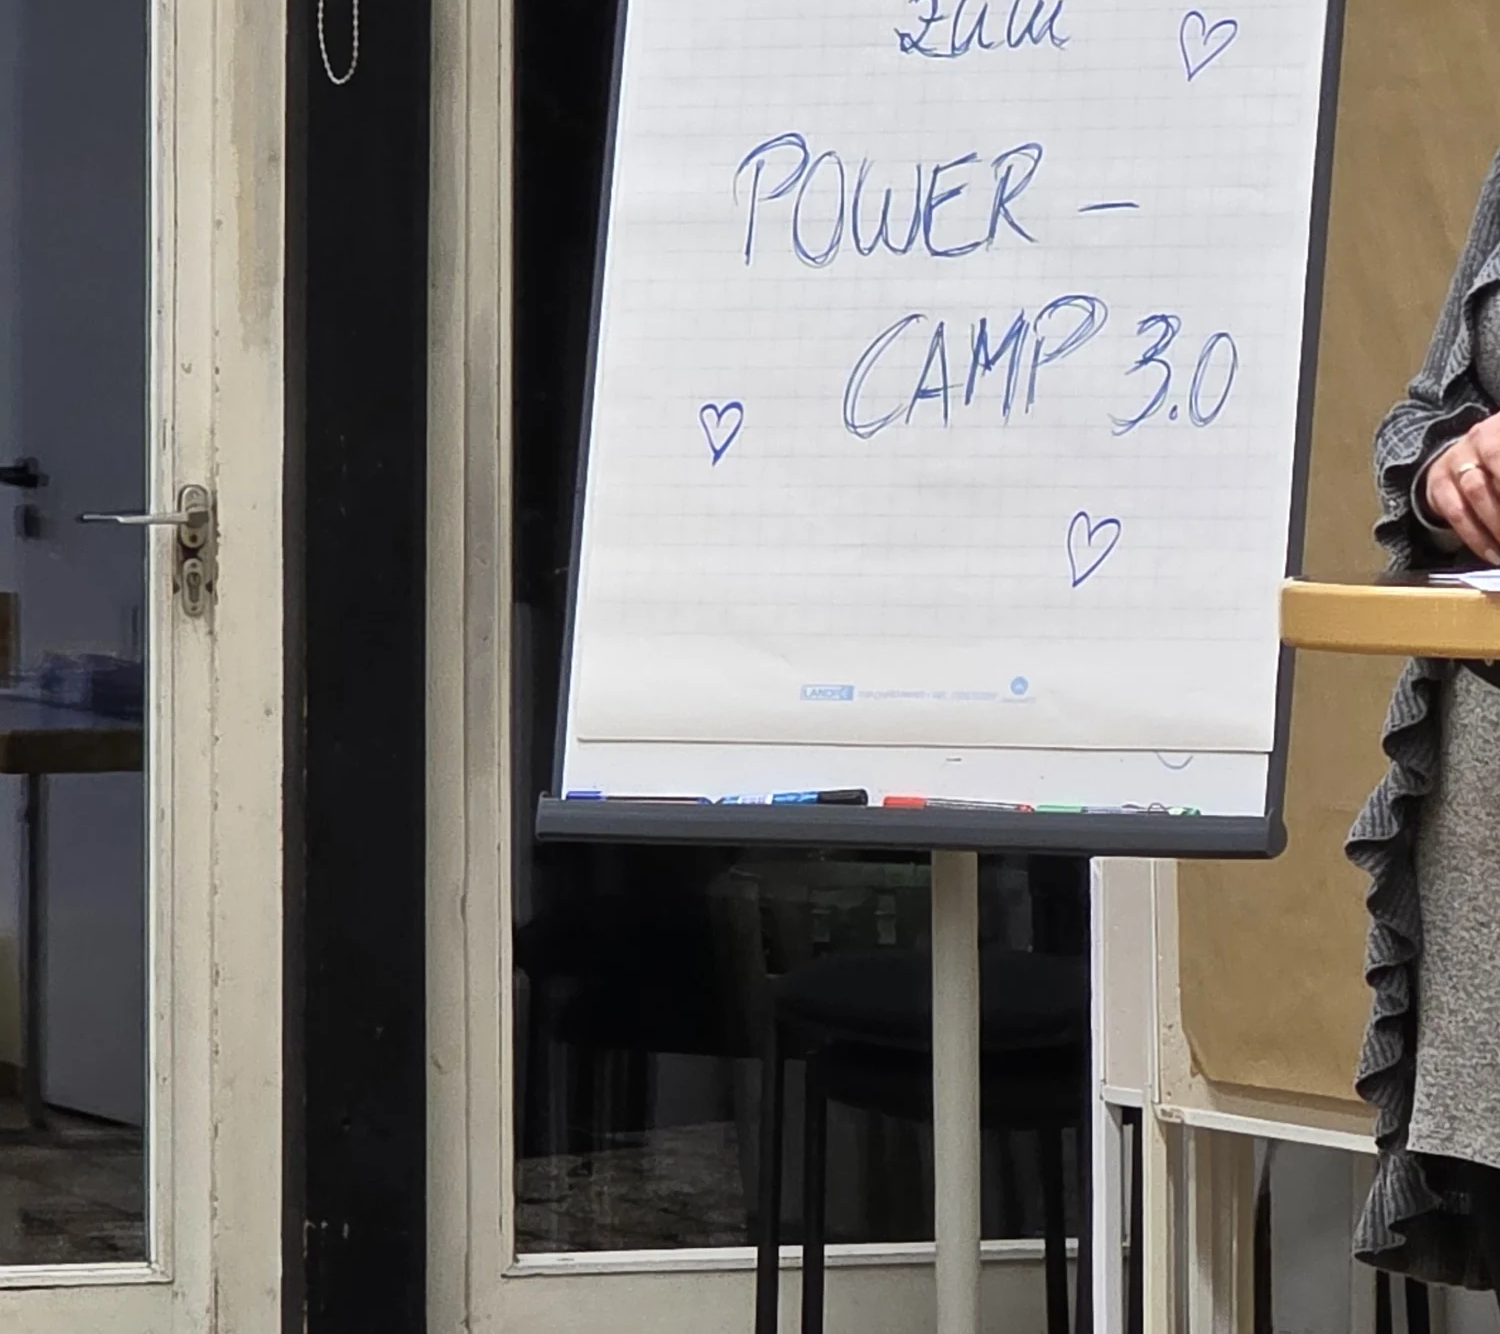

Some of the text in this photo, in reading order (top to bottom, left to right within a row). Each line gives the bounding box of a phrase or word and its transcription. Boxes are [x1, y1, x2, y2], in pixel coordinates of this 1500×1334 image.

[733, 131, 1047, 267] POWER
[842, 293, 1240, 440] CAMP 3.0
